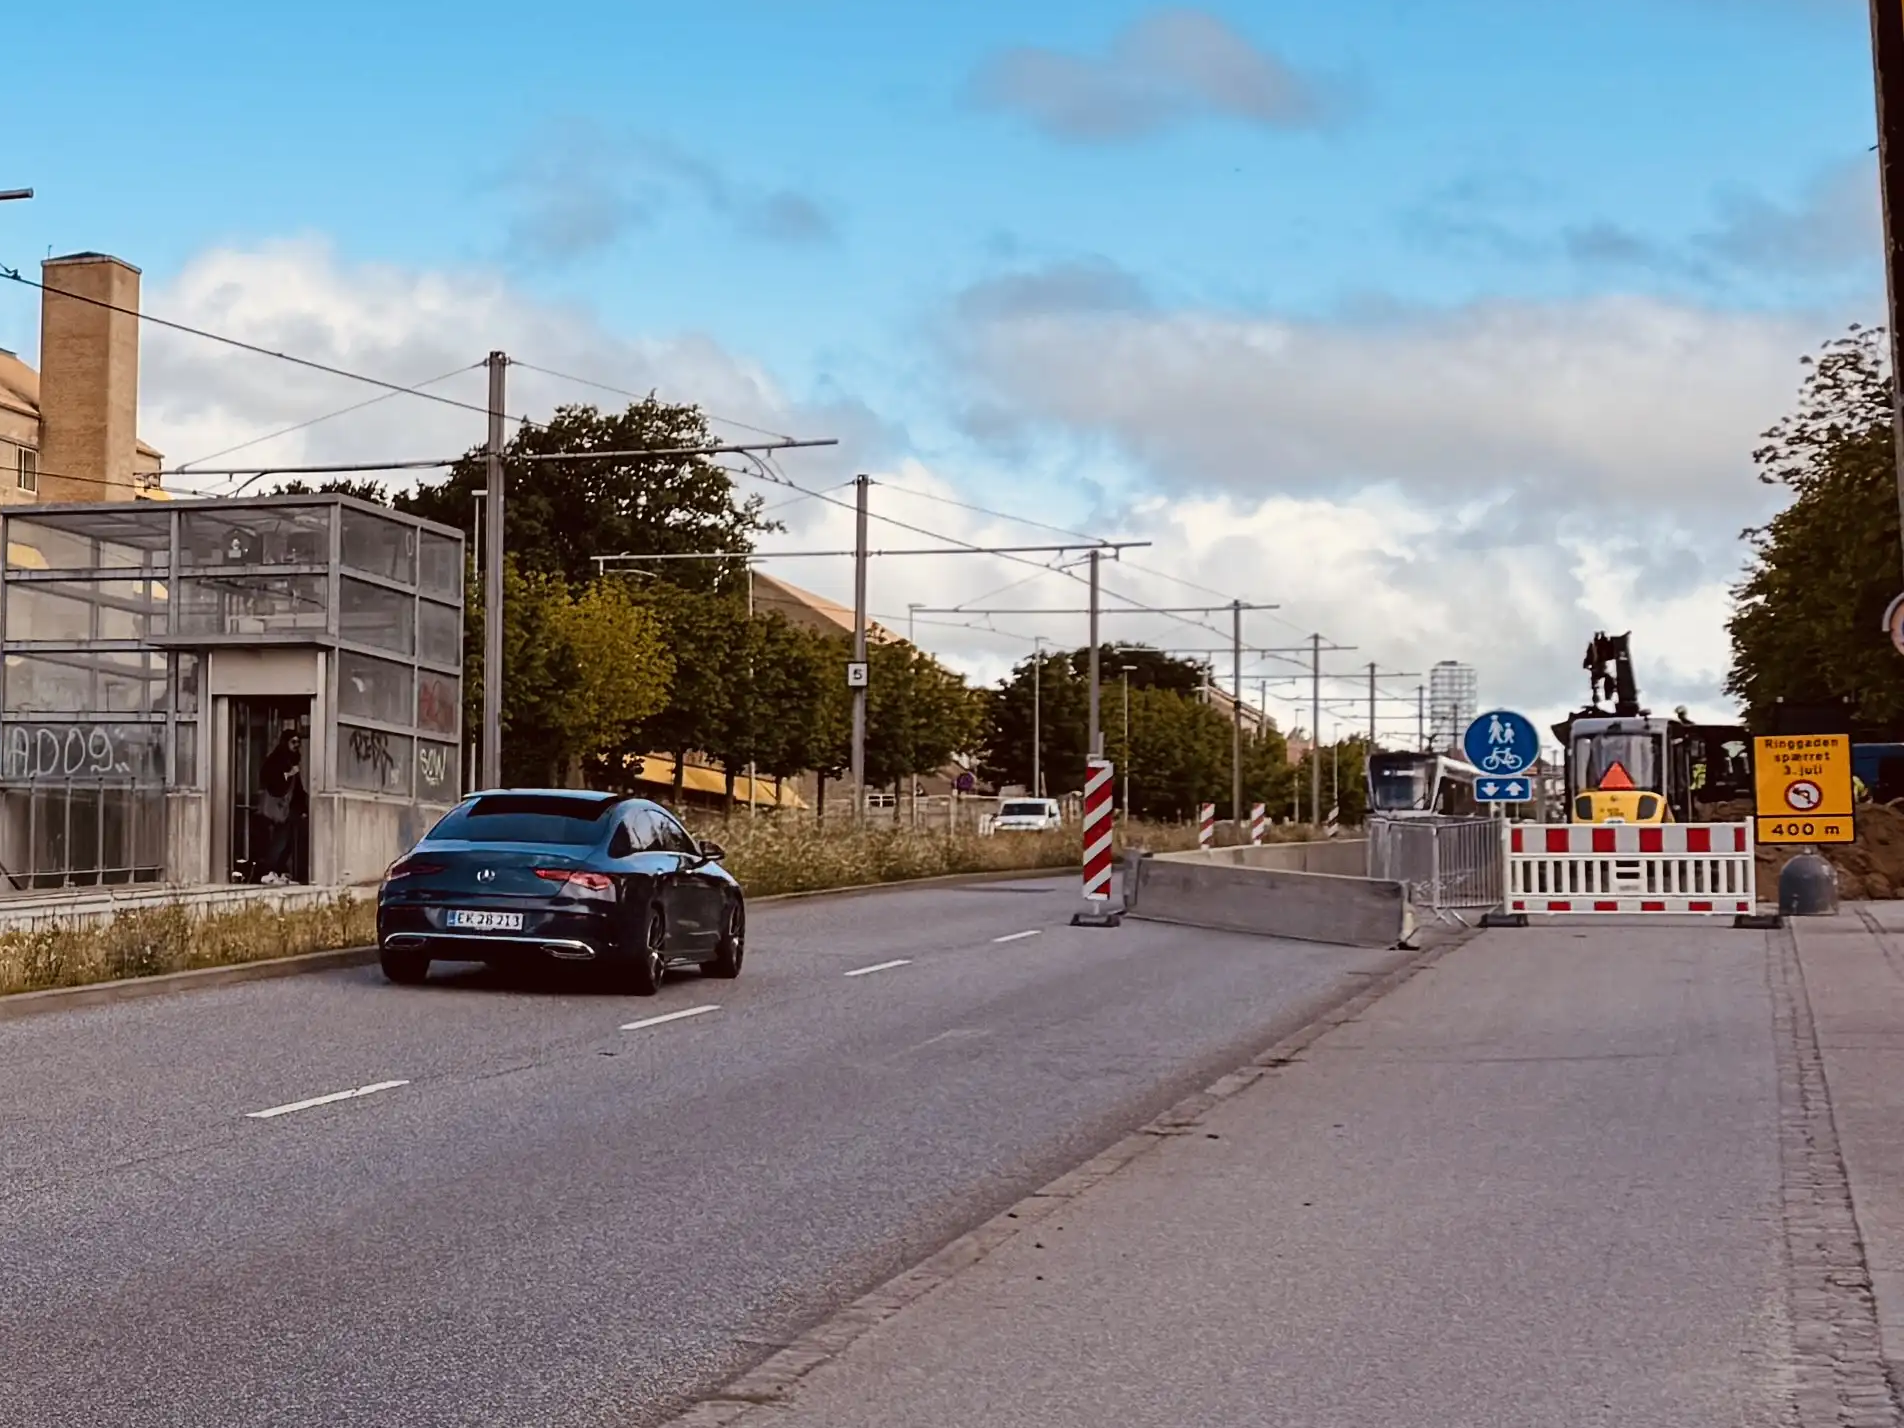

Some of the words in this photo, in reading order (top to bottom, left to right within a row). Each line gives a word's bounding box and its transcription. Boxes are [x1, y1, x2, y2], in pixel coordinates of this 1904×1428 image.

[1765, 739, 1838, 750] Ringgaden
[1775, 752, 1830, 762] spærret
[1800, 764, 1822, 776] juli
[1771, 823, 1814, 836] 400
[1825, 826, 1840, 835] m
